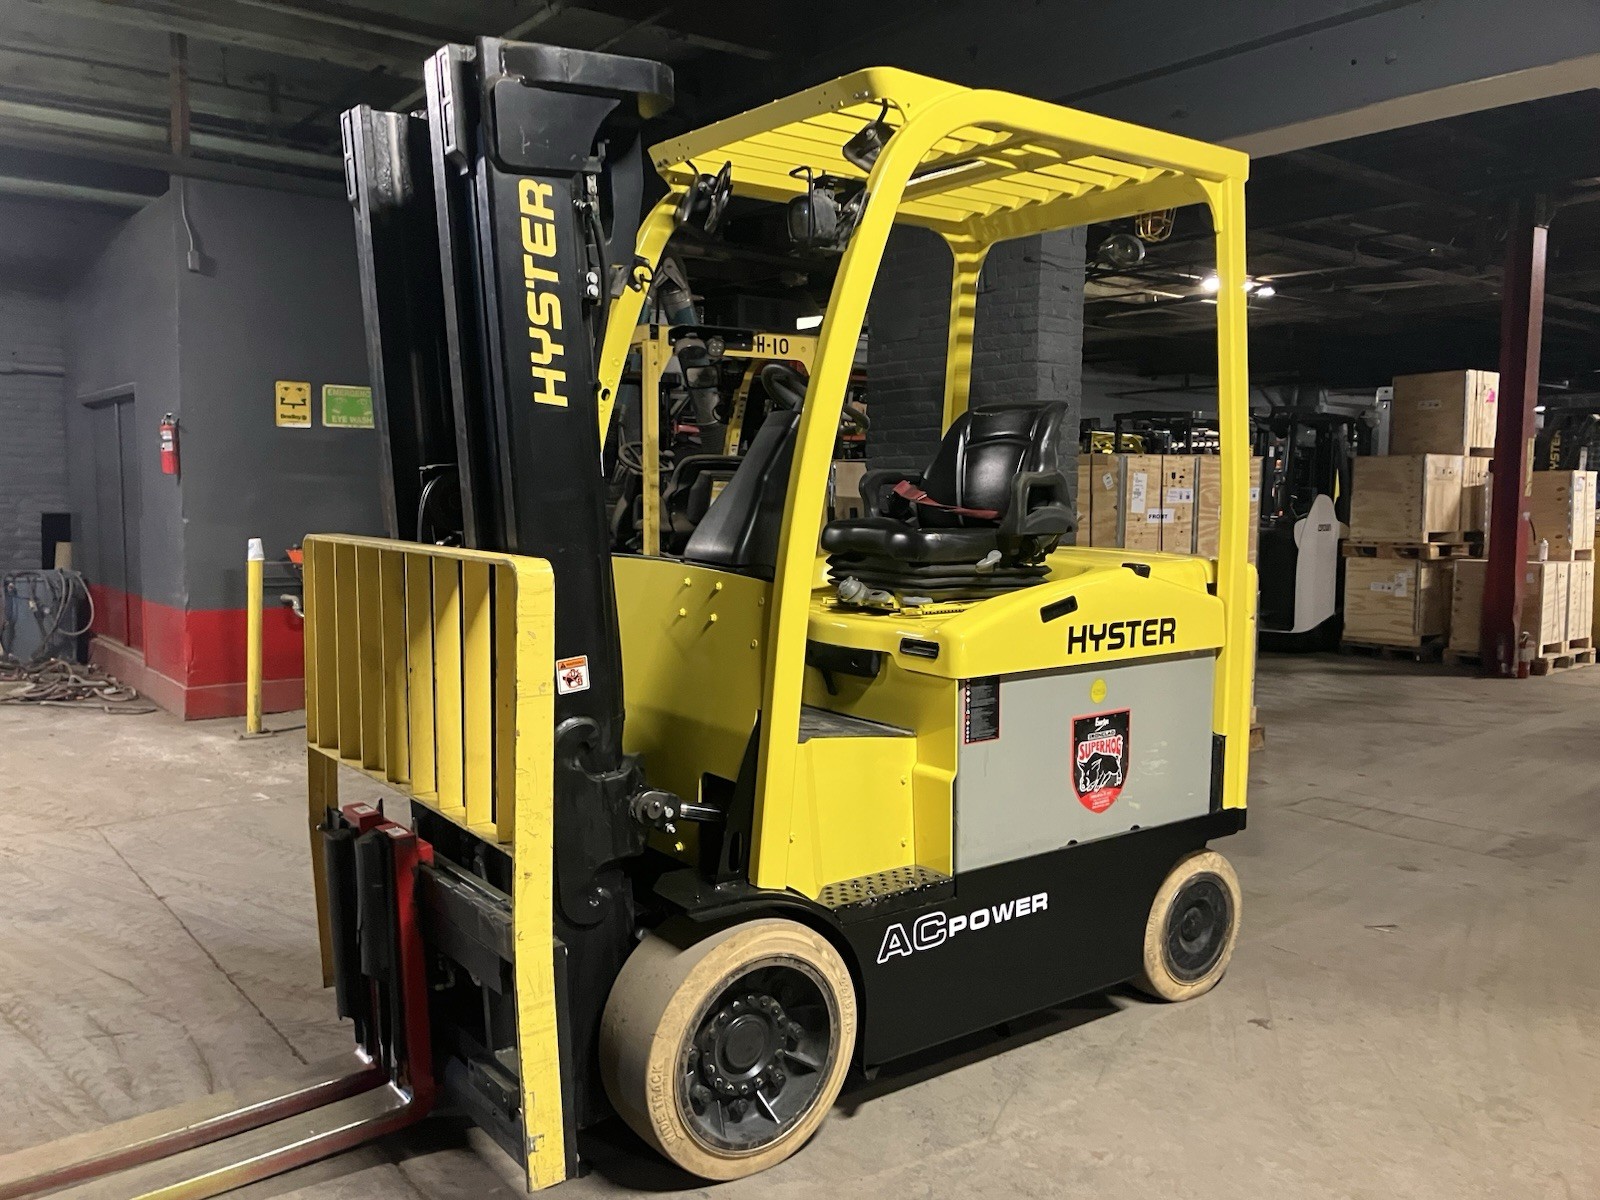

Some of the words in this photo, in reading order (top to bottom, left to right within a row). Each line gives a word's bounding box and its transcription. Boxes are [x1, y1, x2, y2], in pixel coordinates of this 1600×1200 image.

[518, 178, 568, 408] HYSTER
[756, 335, 789, 355] H-10
[327, 388, 372, 398] EMERGENC
[331, 415, 348, 423] EYE
[349, 416, 374, 424] WASH
[1549, 429, 1562, 470] YSTER
[1067, 617, 1176, 655] HYSTER
[1079, 736, 1122, 761] SUPERHOG
[877, 911, 947, 964] AC
[948, 892, 1049, 938] POWER
[651, 1063, 664, 1113] TRACK
[655, 1113, 678, 1147] WIDE
